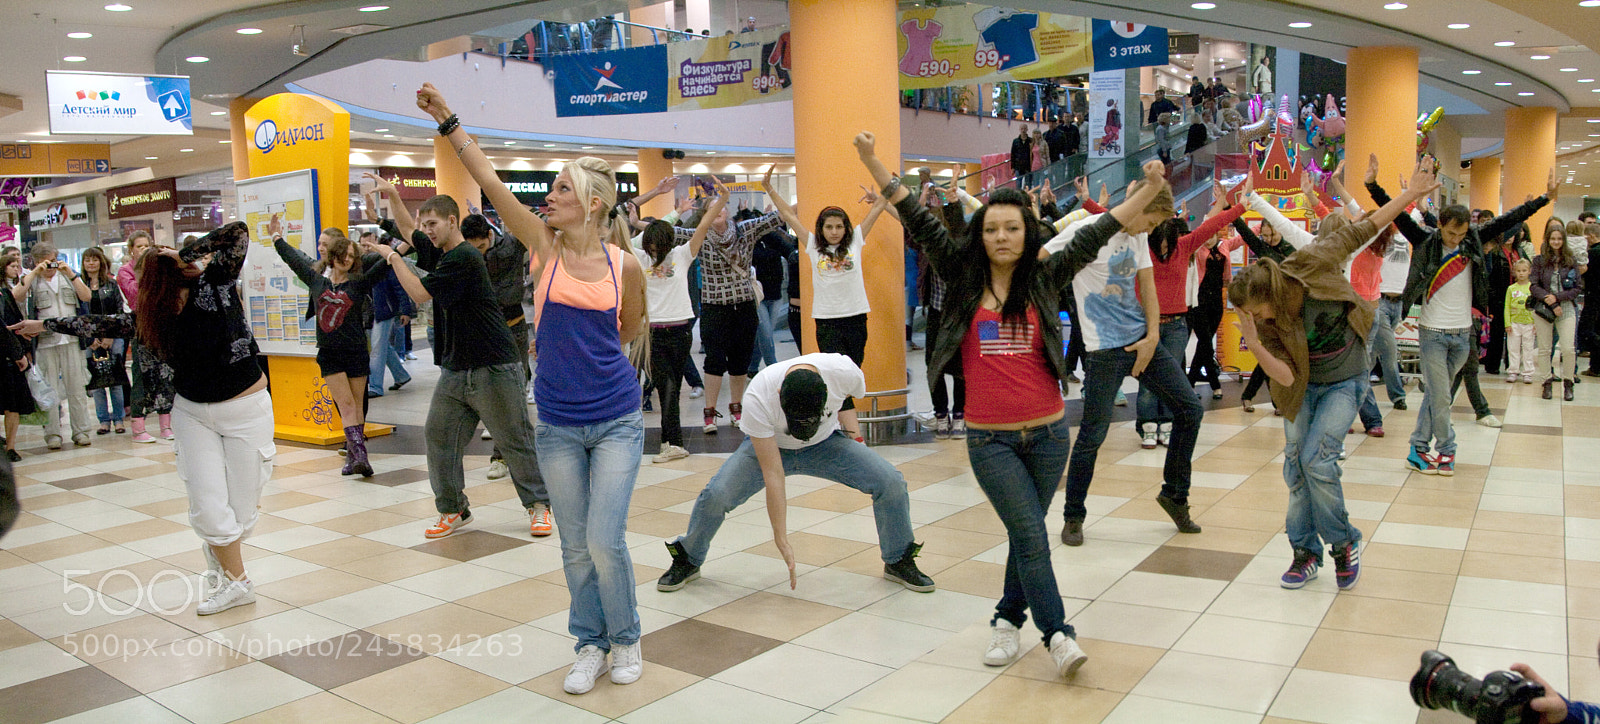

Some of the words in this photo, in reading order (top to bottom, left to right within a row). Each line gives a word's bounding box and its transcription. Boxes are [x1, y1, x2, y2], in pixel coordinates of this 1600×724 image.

[1109, 46, 1117, 58] 3
[1120, 44, 1152, 57] этаж
[682, 60, 750, 77] Физкультура
[682, 72, 741, 87] начинается
[570, 90, 648, 106] спортмастер
[682, 85, 716, 97] здесь
[61, 103, 110, 115] Детский
[113, 105, 137, 118] мир
